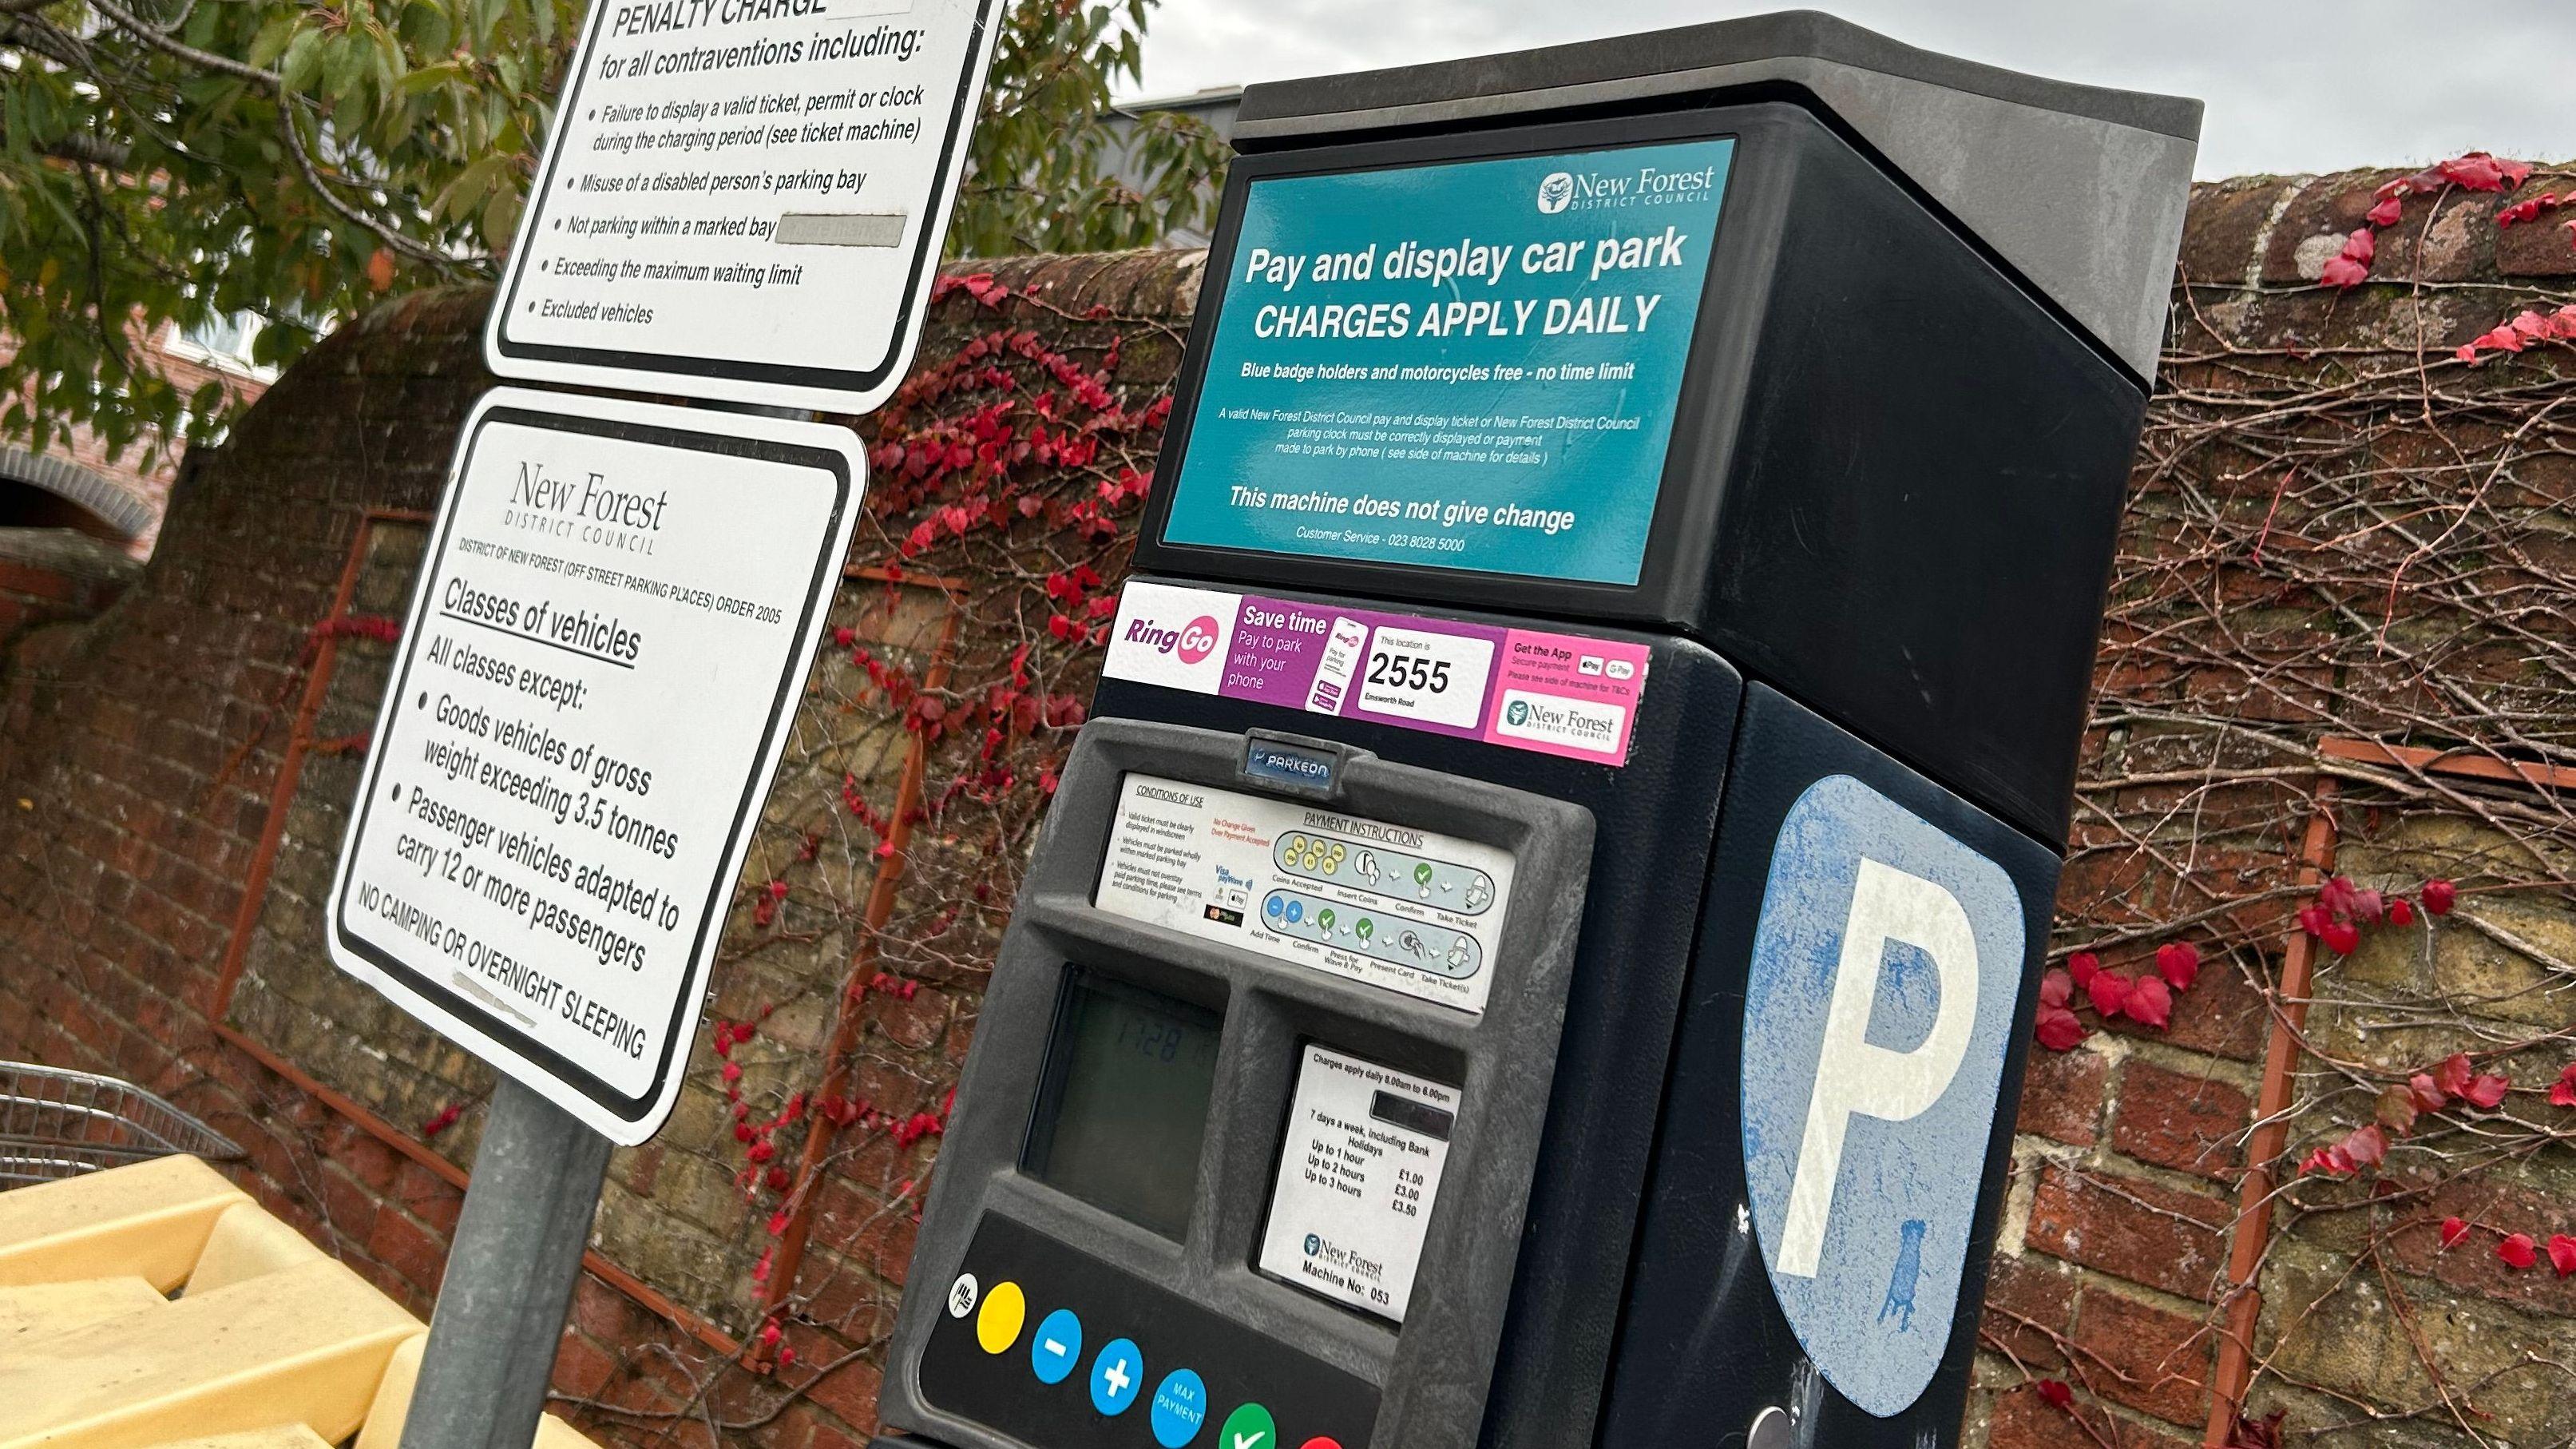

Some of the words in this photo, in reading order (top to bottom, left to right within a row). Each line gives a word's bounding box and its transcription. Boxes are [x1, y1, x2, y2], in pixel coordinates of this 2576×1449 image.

[612, 0, 718, 38] PENALTY
[599, 54, 628, 80] for
[628, 50, 654, 77] all
[654, 37, 804, 75] contraventions
[807, 25, 925, 62] including:
[601, 104, 644, 123] Failure
[645, 103, 659, 121] to
[661, 99, 710, 124] display
[710, 101, 720, 117] a
[723, 94, 759, 116] valid
[759, 93, 801, 115] ticket,
[803, 88, 857, 117] permit
[858, 91, 878, 109] or
[879, 84, 925, 108] clock
[580, 173, 624, 193] Misuse
[625, 173, 642, 192] of
[640, 177, 650, 192] a
[652, 171, 711, 192] disabled
[708, 169, 773, 196] person's
[774, 169, 834, 196] parking
[836, 168, 868, 195] bay
[1572, 173, 1632, 199] New
[1635, 165, 1715, 194] Forest
[1571, 196, 1636, 210] DISTRICT
[1644, 191, 1709, 205] COUNCIL
[554, 256, 619, 283] Exceeding
[620, 259, 642, 279] the
[643, 260, 710, 281] maximum
[713, 262, 766, 289] waiting
[767, 263, 803, 285] limit
[1245, 248, 1306, 292] Pay
[1311, 243, 1377, 282] and
[1383, 238, 1513, 288] display
[1521, 240, 1586, 274] car
[1590, 225, 1689, 281] park
[541, 298, 600, 320] Excluded
[600, 303, 654, 324] vehicles
[1254, 302, 1411, 339] CHARGES
[1416, 300, 1538, 337] APPLY
[1543, 294, 1663, 335] DAILY
[1241, 362, 1271, 378] Blue
[1273, 363, 1314, 383] badge
[1317, 363, 1369, 380] holders
[1370, 363, 1399, 380] and
[1400, 363, 1490, 384] motorcycles
[1493, 363, 1524, 381] free
[1535, 367, 1557, 381] no
[1559, 363, 1595, 380] time
[1598, 362, 1635, 379] limit
[509, 462, 577, 513] New
[577, 472, 668, 531] Forest
[1231, 486, 1267, 508] This
[1270, 490, 1349, 514] machine
[1353, 494, 1401, 518] does
[1404, 499, 1441, 521] not
[1442, 499, 1488, 527] give
[1492, 502, 1575, 535] change
[504, 509, 575, 538] DISTRICT
[582, 525, 653, 556] COUNCIL
[1296, 526, 1343, 541] Customer
[1342, 529, 1380, 545] Service
[1388, 534, 1409, 547] 023
[1409, 535, 1437, 550] 8028
[1437, 538, 1465, 552] 5000
[458, 537, 497, 558] DISTRICT
[496, 546, 509, 560] OF
[508, 548, 529, 566] NEW
[529, 553, 565, 574] FOREST
[564, 562, 587, 578] (OFF
[586, 566, 624, 588] STREET
[624, 574, 669, 598] PARKING
[668, 585, 715, 613] PLACES)
[715, 595, 755, 618] ORDER
[755, 605, 783, 625] 2005
[445, 577, 520, 627] Classes
[523, 600, 550, 634] of
[550, 609, 641, 661] vehicles
[1243, 605, 1286, 629] Save
[1288, 610, 1327, 635] time
[1124, 617, 1213, 655] RingGo
[1238, 630, 1260, 649] Pay
[1262, 634, 1274, 649] to
[1275, 637, 1302, 653] park
[1381, 636, 1395, 646] This
[1395, 638, 1423, 649] location
[1514, 642, 1532, 654] Get
[1532, 645, 1550, 657] the
[1550, 647, 1572, 661] App
[426, 634, 454, 666] All
[453, 644, 517, 687] classes
[518, 669, 588, 713] except:
[1234, 651, 1258, 667] with
[1258, 657, 1286, 672] your
[1367, 652, 1452, 694] 2555
[1227, 672, 1264, 689] phone
[1528, 704, 1564, 724] New
[1567, 710, 1614, 733] Forest
[436, 693, 490, 738] Goods
[493, 719, 568, 765] vehicles
[570, 744, 595, 774] of
[591, 755, 652, 796] gross
[1266, 754, 1329, 777] PARKEON
[424, 739, 480, 780] weight
[480, 762, 573, 825] exceeding
[574, 792, 608, 830] 3.5
[608, 804, 679, 859] tonnes
[1303, 810, 1350, 832] PAYMENT
[1349, 820, 1425, 848] INSTRUCTIONS
[1337, 889, 1357, 900] Insert
[1358, 894, 1378, 906] Coins
[1437, 912, 1454, 923] Take
[1455, 916, 1478, 929] Ticket
[359, 880, 380, 911] NO
[381, 893, 442, 946] CAMPING
[443, 927, 467, 961] OR
[467, 940, 563, 1010] OVERNIGHT
[561, 990, 646, 1061] SLEEPING
[1776, 856, 1979, 1278] P
[1311, 1138, 1324, 1153] Up
[1326, 1143, 1335, 1156] to
[1337, 1147, 1342, 1159] 1
[1343, 1149, 1365, 1166] hour
[1305, 1167, 1317, 1183] Up
[1318, 1173, 1328, 1185] to
[1329, 1176, 1335, 1189] 3
[1336, 1179, 1362, 1198] hours
[1307, 1153, 1320, 1167] Up
[1322, 1158, 1331, 1170] to
[1331, 1161, 1339, 1174] 2
[1339, 1163, 1365, 1183] hours
[1398, 1168, 1424, 1187] £1.00
[1394, 1183, 1420, 1201] £3.00
[1391, 1199, 1417, 1217] £3.50
[1302, 1260, 1345, 1288] Machine
[1346, 1276, 1365, 1296] No:
[1370, 1287, 1389, 1306] 053
[1173, 1382, 1195, 1402] MAX
[1157, 1394, 1202, 1425] PAYMENT
